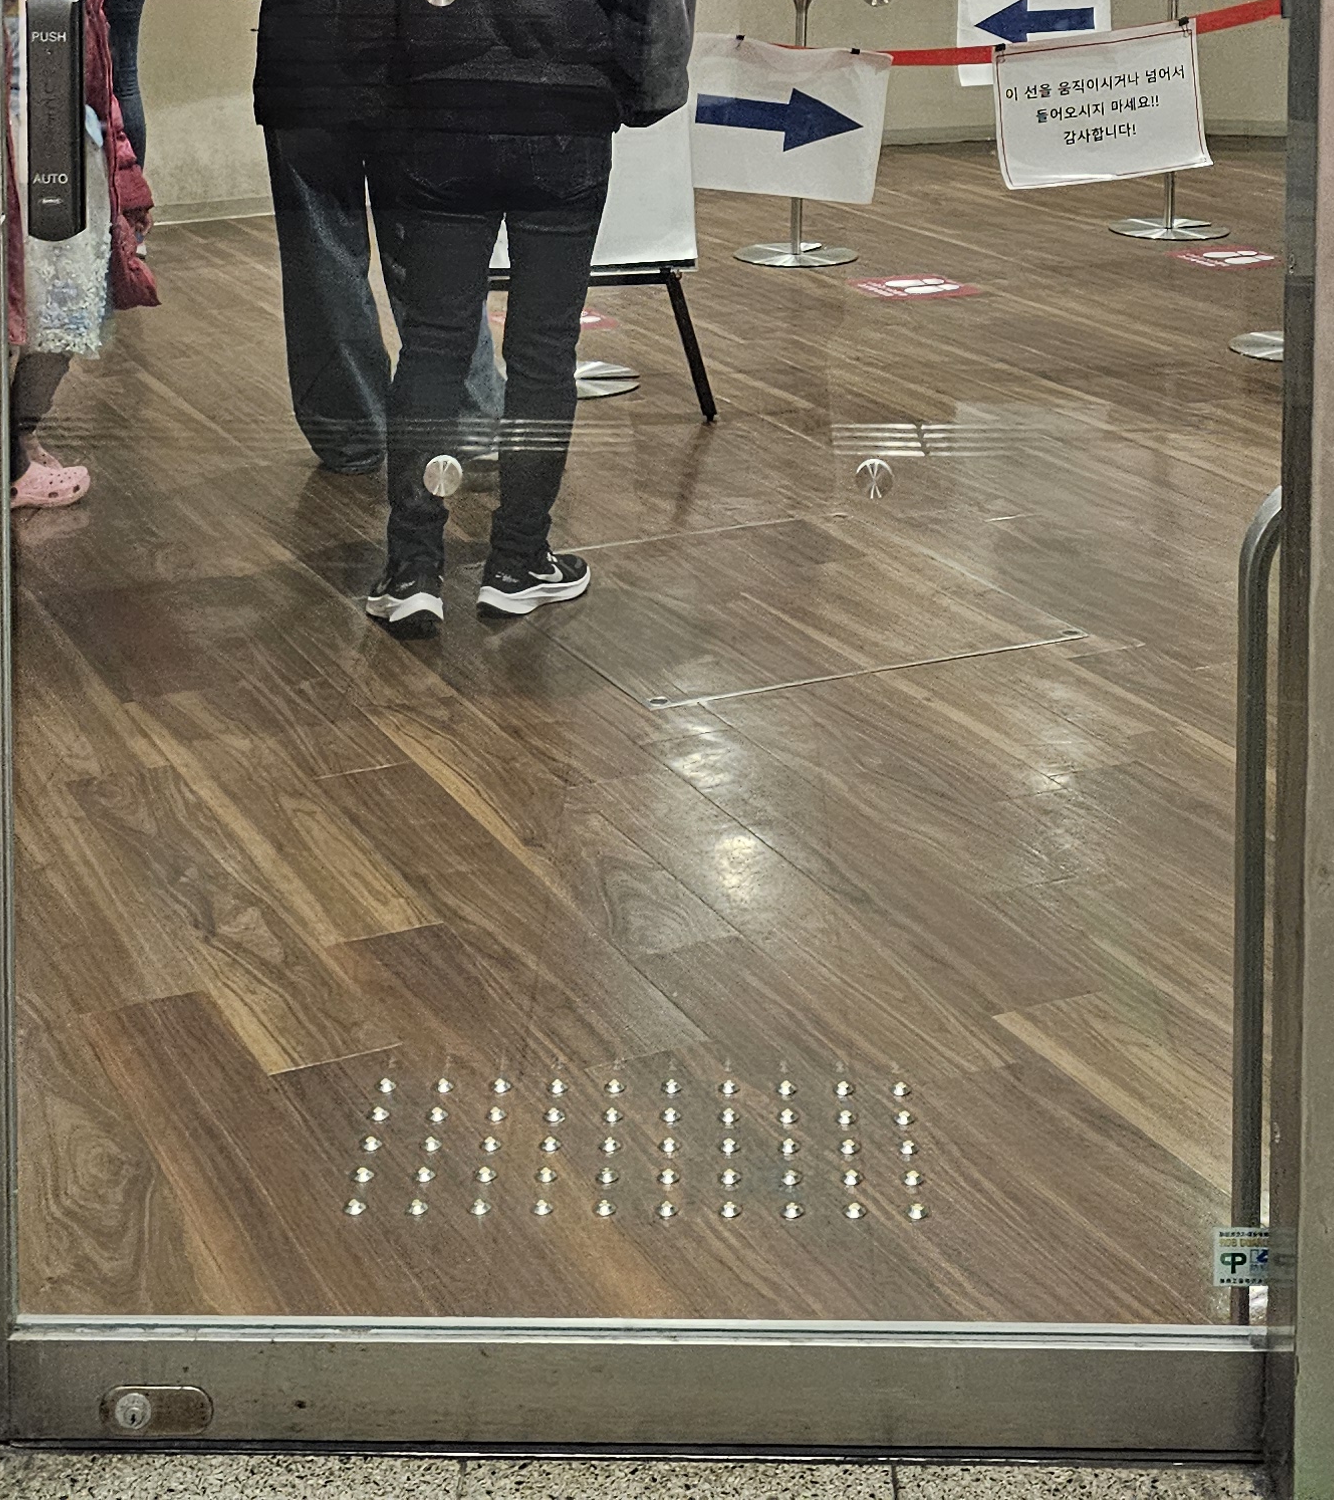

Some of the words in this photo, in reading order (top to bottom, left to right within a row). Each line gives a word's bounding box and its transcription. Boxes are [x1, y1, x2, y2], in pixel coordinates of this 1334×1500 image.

[31, 31, 67, 42] PUSH
[1006, 87, 1017, 101] 이
[1025, 84, 1051, 99] 선을
[1058, 72, 1139, 95] 움직이시거나
[1146, 65, 1184, 83] 넘어서
[1036, 102, 1104, 123] 들어오시지
[1112, 95, 1159, 113] 마세요!!
[1064, 123, 1136, 145] 감사합니다!
[33, 173, 69, 184] AUTO
